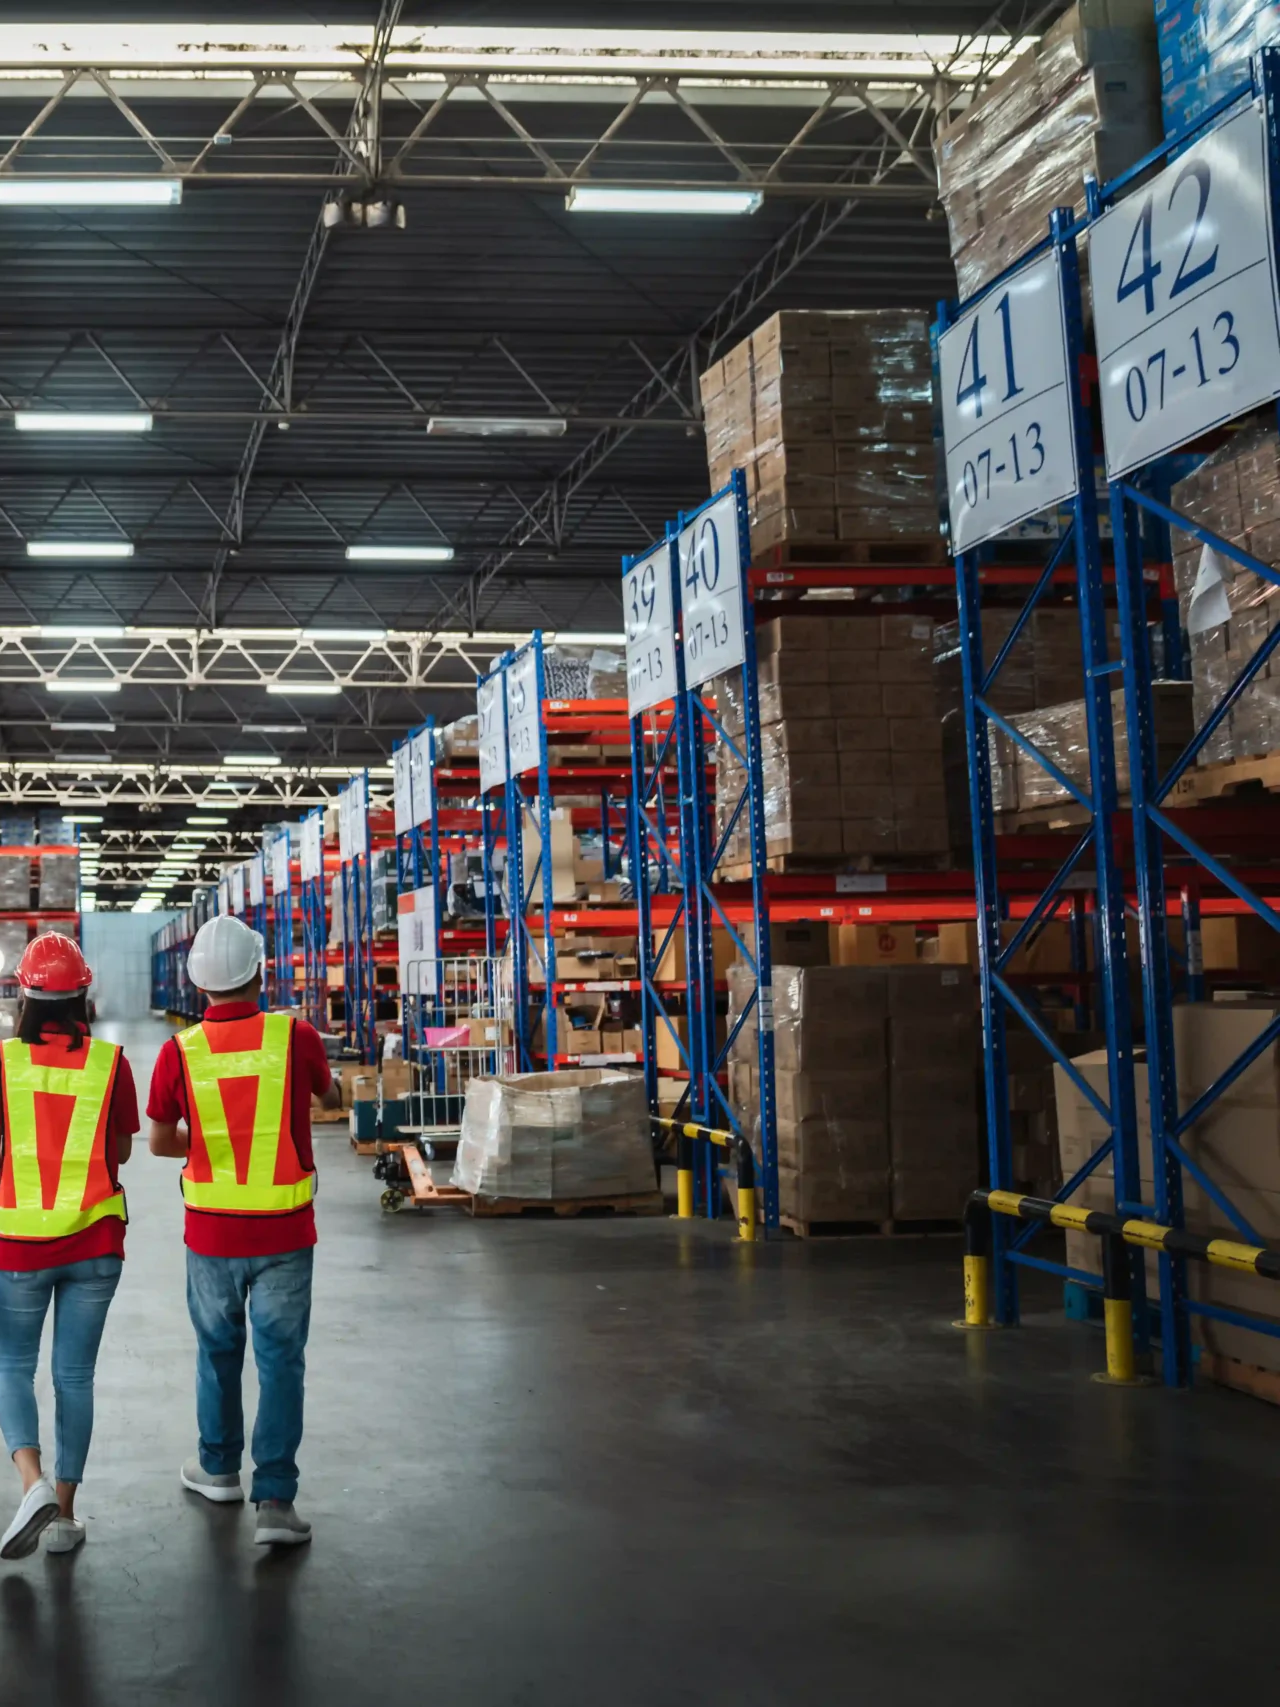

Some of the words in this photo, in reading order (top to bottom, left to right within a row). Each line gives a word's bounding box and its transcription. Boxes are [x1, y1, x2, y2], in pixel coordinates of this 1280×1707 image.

[1116, 158, 1219, 315] 42
[956, 291, 1024, 419] 41
[1125, 310, 1240, 423] 07-13
[963, 422, 1046, 509] 07-13
[685, 517, 720, 600] 40
[628, 563, 656, 642] 39
[687, 610, 729, 660] 07-13
